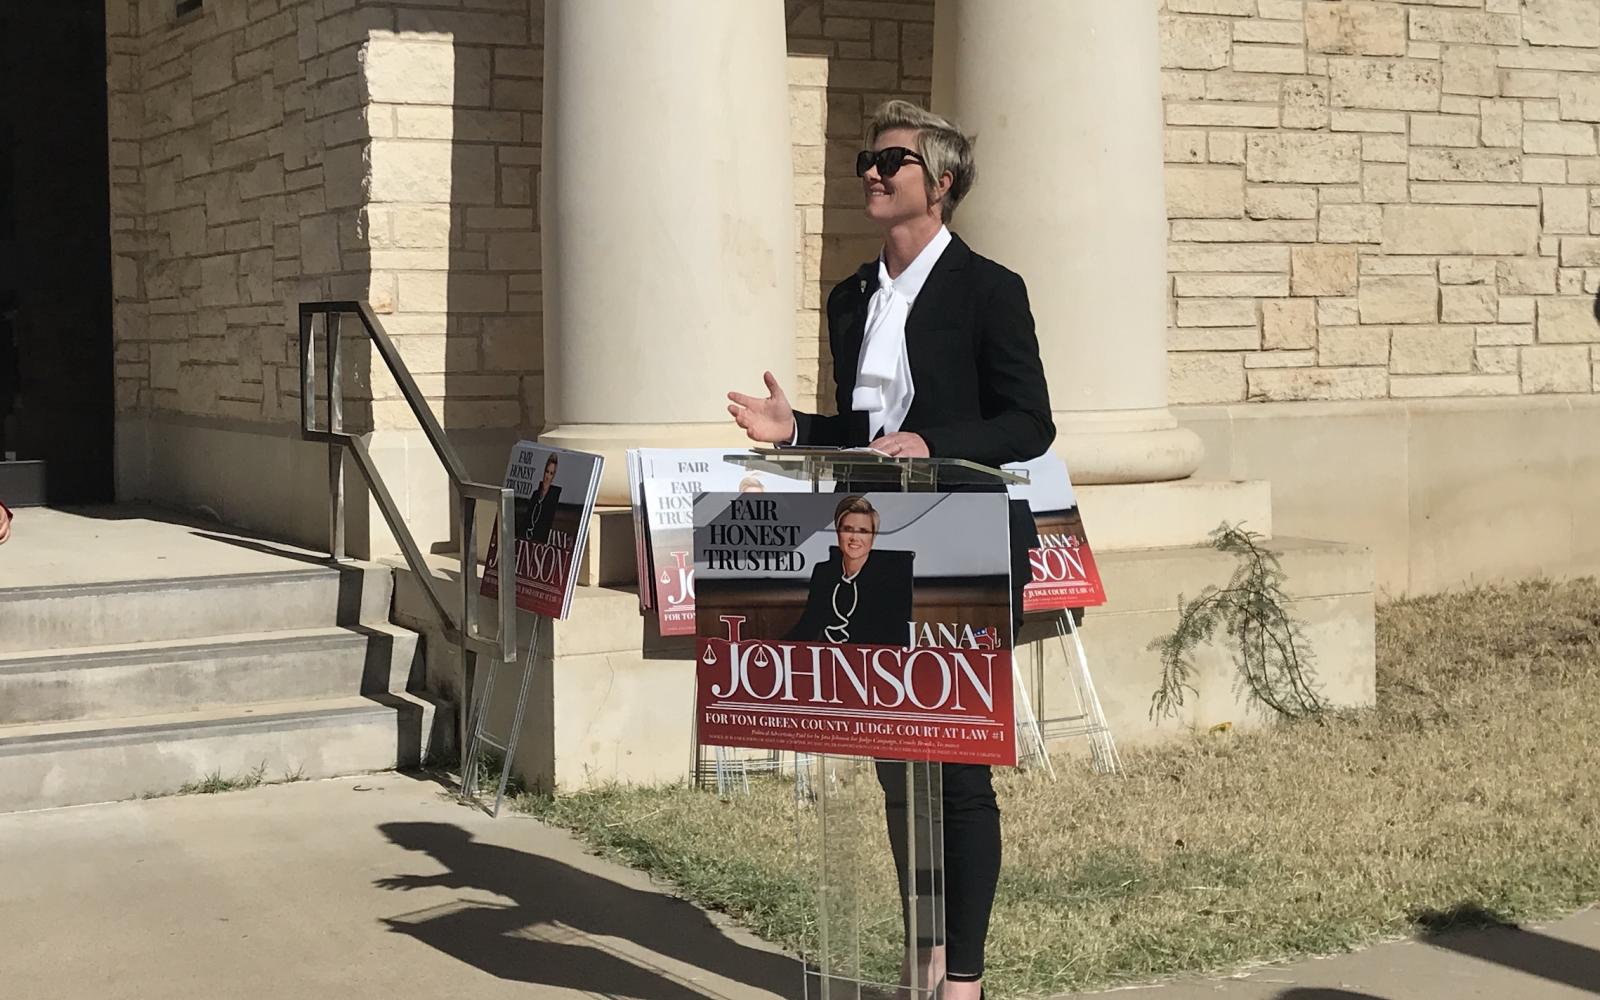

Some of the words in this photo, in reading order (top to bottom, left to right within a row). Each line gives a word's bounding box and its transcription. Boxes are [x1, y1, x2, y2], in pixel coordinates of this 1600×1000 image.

[510, 464, 536, 480] HONEST
[678, 462, 709, 473] FAIR
[671, 481, 703, 494] FAIR
[658, 496, 693, 510] HON
[730, 500, 778, 521] FAIR
[656, 511, 693, 525] TRUS
[709, 523, 801, 547] HONEST
[1036, 533, 1072, 551] JANA
[703, 549, 806, 572] TRUSTED
[903, 621, 980, 653] JANA
[711, 615, 998, 713] JOHNSON
[705, 712, 728, 724] FOR
[729, 714, 757, 726] TOM
[759, 716, 799, 729] GREEN
[801, 718, 850, 732] COUNTY
[853, 721, 894, 735] JUDGE
[896, 724, 941, 738] COURT
[942, 727, 960, 739] AT
[961, 728, 989, 741] LAW
[992, 730, 1005, 742] #1
